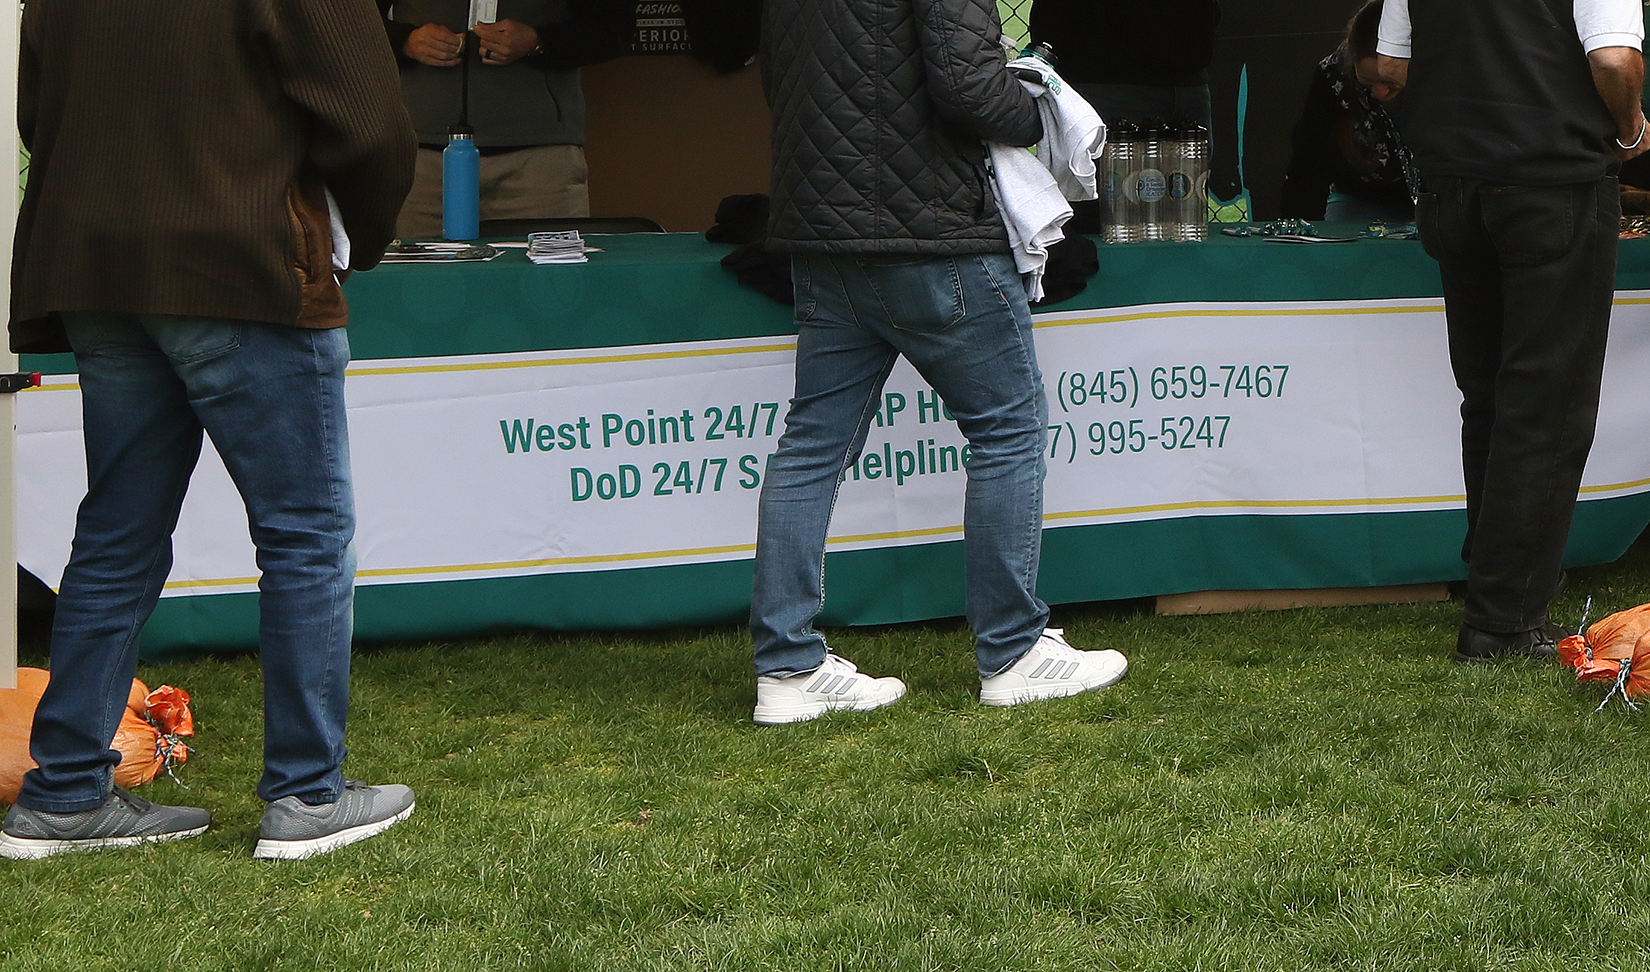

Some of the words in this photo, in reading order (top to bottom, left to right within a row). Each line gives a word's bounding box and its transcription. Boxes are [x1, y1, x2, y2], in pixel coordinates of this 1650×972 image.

[635, 4, 681, 15] FASHIO
[500, 417, 592, 453] West
[603, 409, 695, 448] Point
[704, 402, 779, 440] 24/7
[1056, 368, 1140, 412] (845)
[1150, 364, 1290, 401] 659-7467
[570, 464, 642, 502] DoD
[653, 458, 728, 496] 24/7
[1089, 414, 1232, 456] 995-5247
